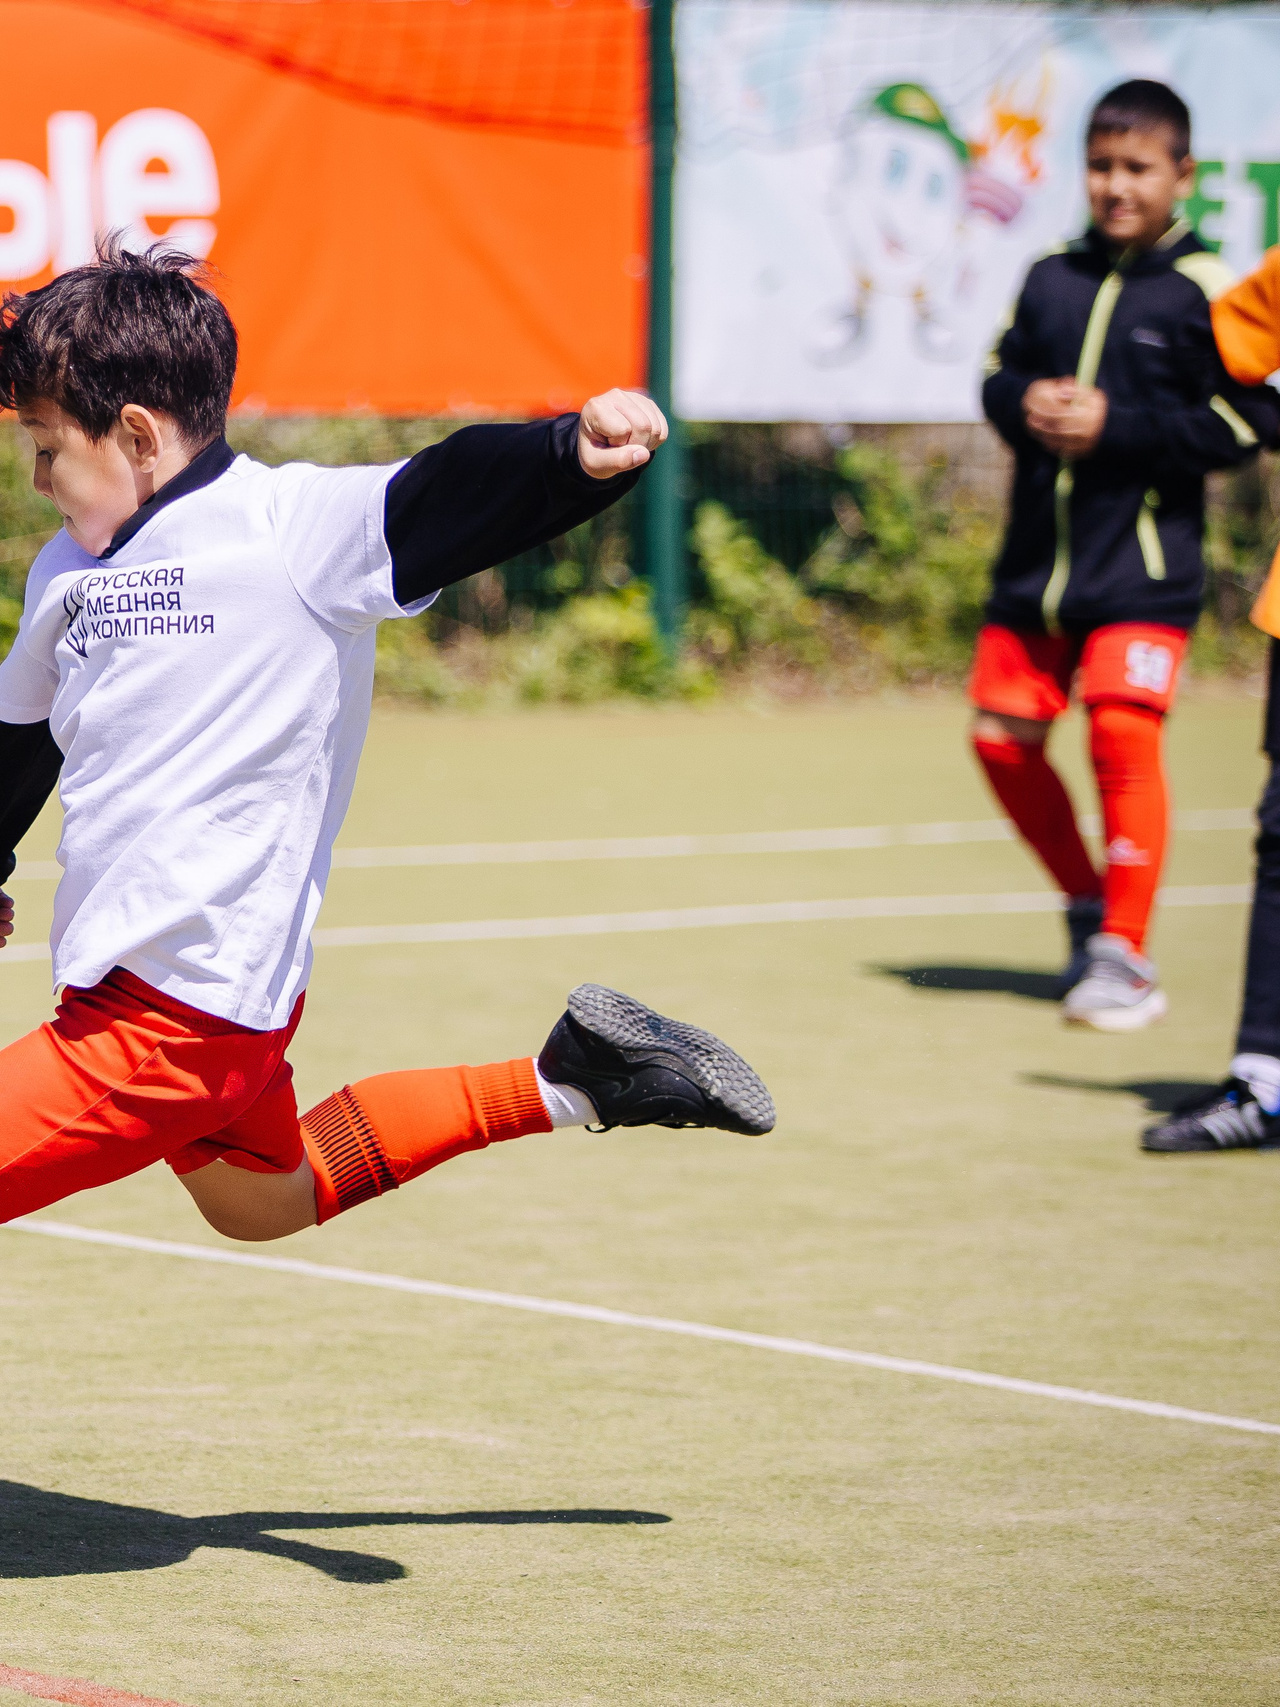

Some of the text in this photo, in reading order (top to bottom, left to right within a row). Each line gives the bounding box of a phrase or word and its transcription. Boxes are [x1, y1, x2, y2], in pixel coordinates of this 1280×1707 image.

[86, 567, 185, 593] РУССКАЯ
[86, 591, 182, 617] МЕДНАЯ
[90, 614, 215, 640] КОМПАНИЯ
